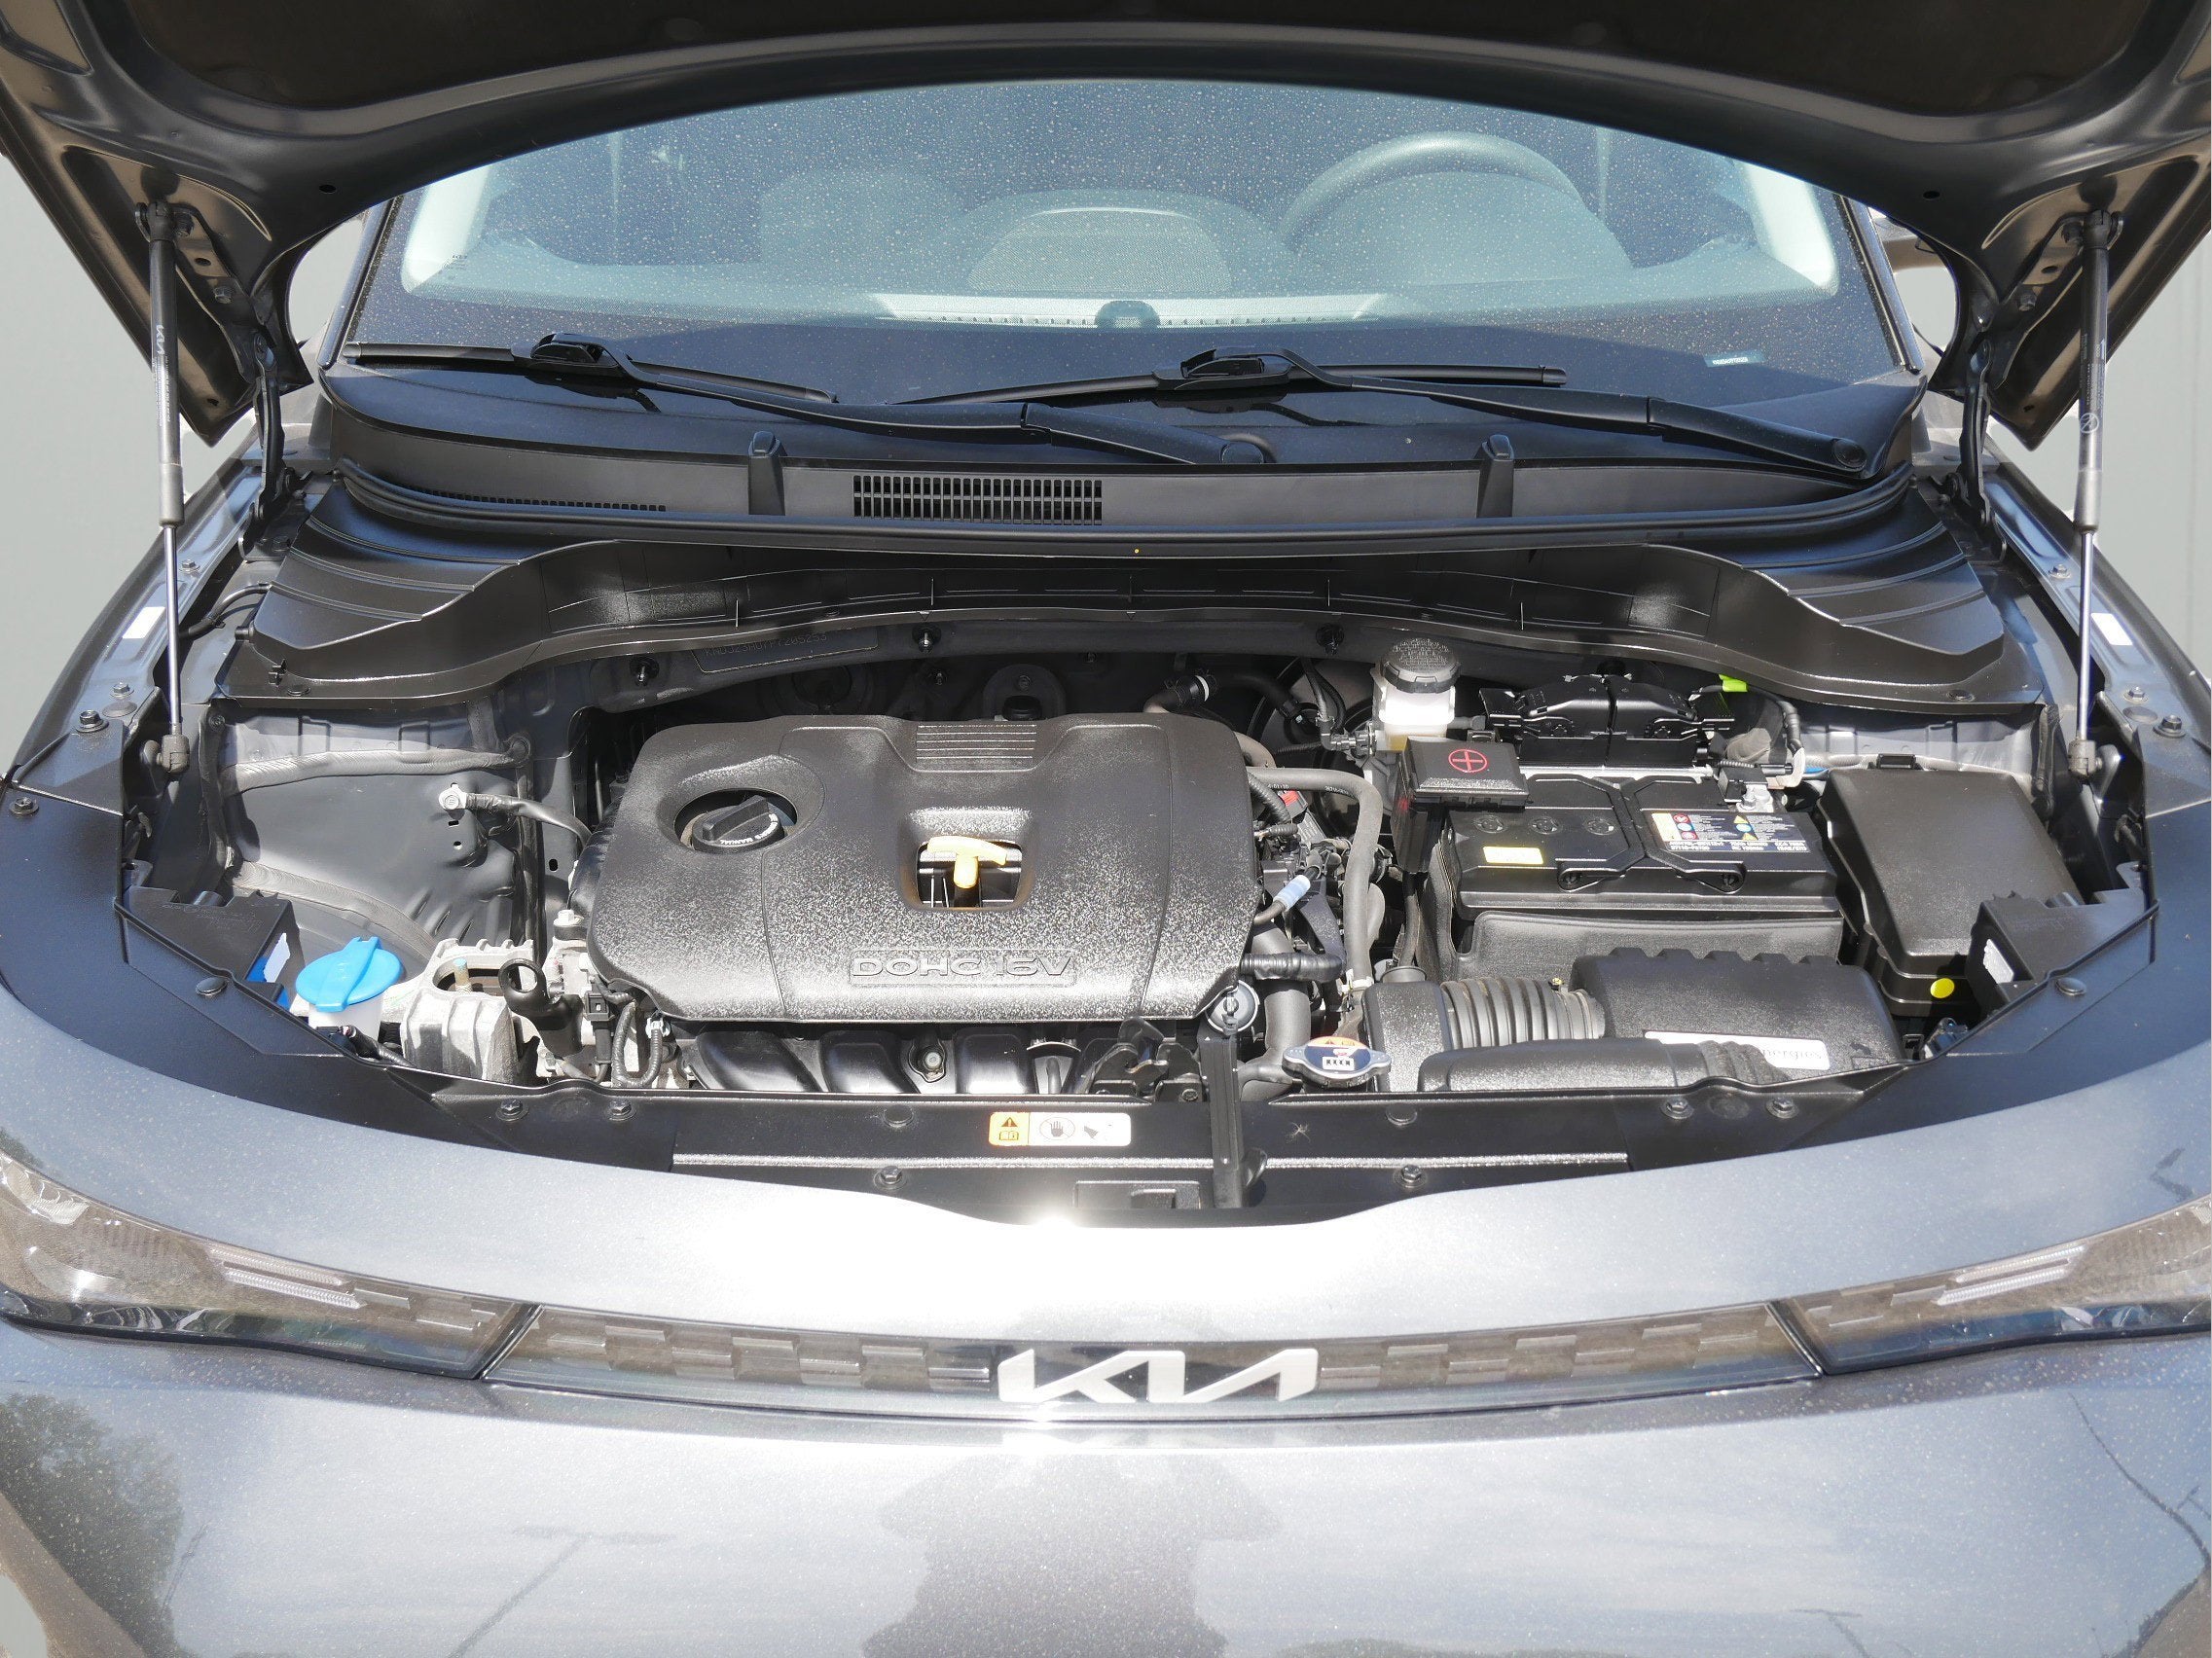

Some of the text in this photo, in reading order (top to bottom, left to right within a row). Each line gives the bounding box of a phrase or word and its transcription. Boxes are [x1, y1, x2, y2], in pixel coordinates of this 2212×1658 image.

[852, 956, 1071, 977] DOHC 16V
[997, 1348, 1320, 1403] KIA
